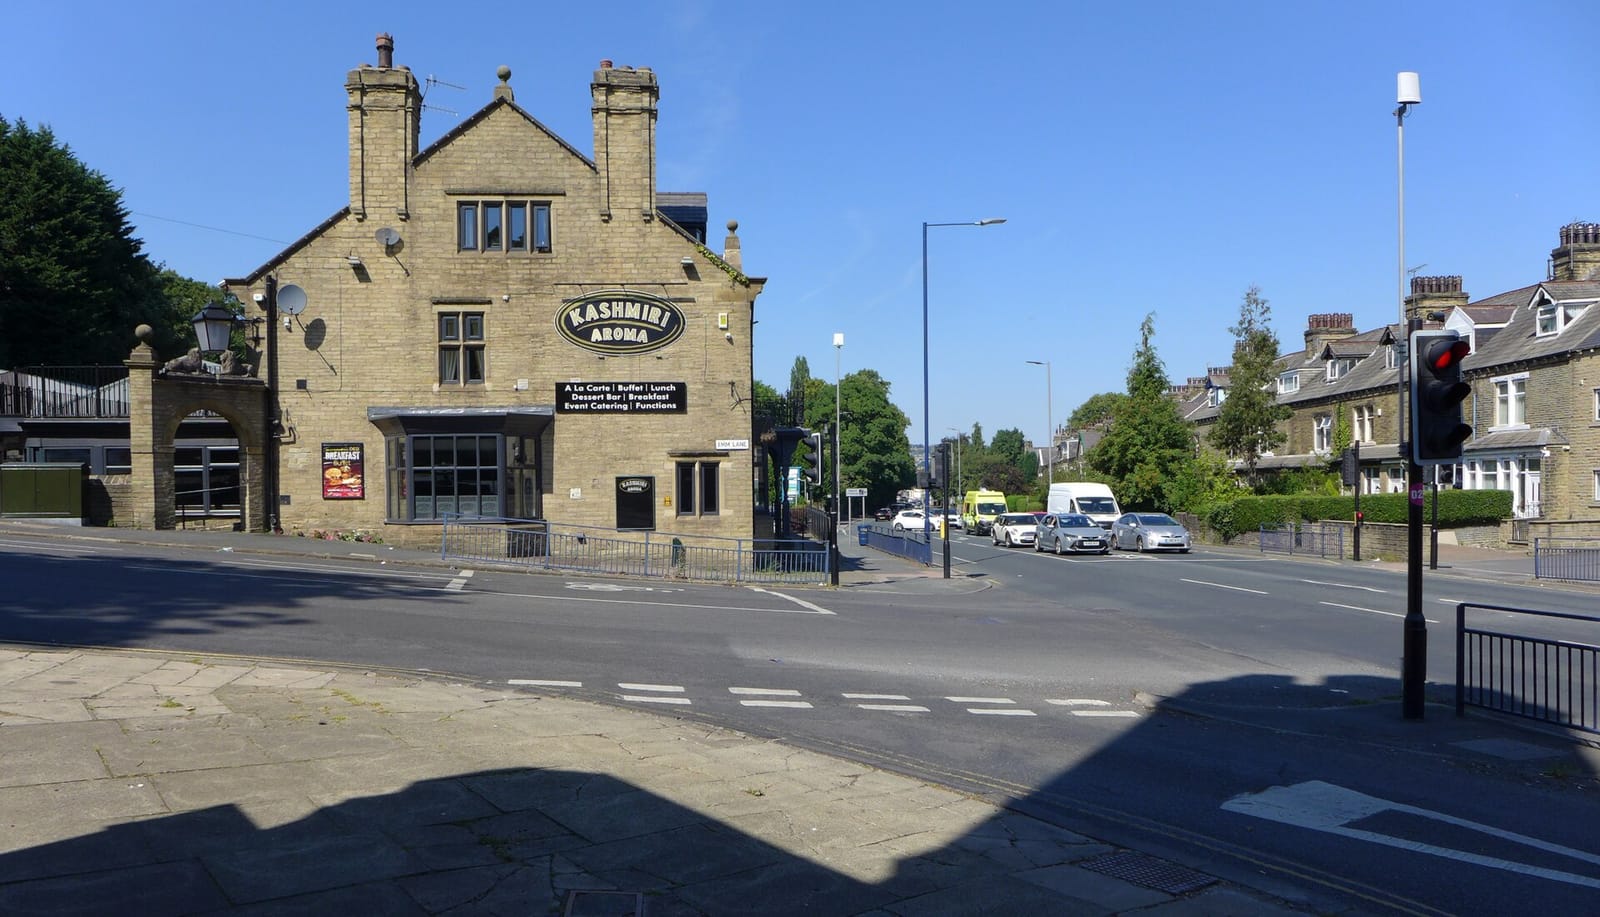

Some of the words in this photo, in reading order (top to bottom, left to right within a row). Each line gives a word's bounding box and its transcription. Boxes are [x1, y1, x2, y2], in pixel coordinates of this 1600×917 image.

[569, 301, 671, 328] KASHMIRI
[591, 328, 648, 343] AROMA
[618, 384, 643, 392] Buffet
[651, 384, 676, 392] Lunch
[590, 402, 628, 411] Catering
[635, 402, 677, 410] Functions
[732, 440, 747, 448] LANE
[325, 451, 361, 460] BREAKFAST
